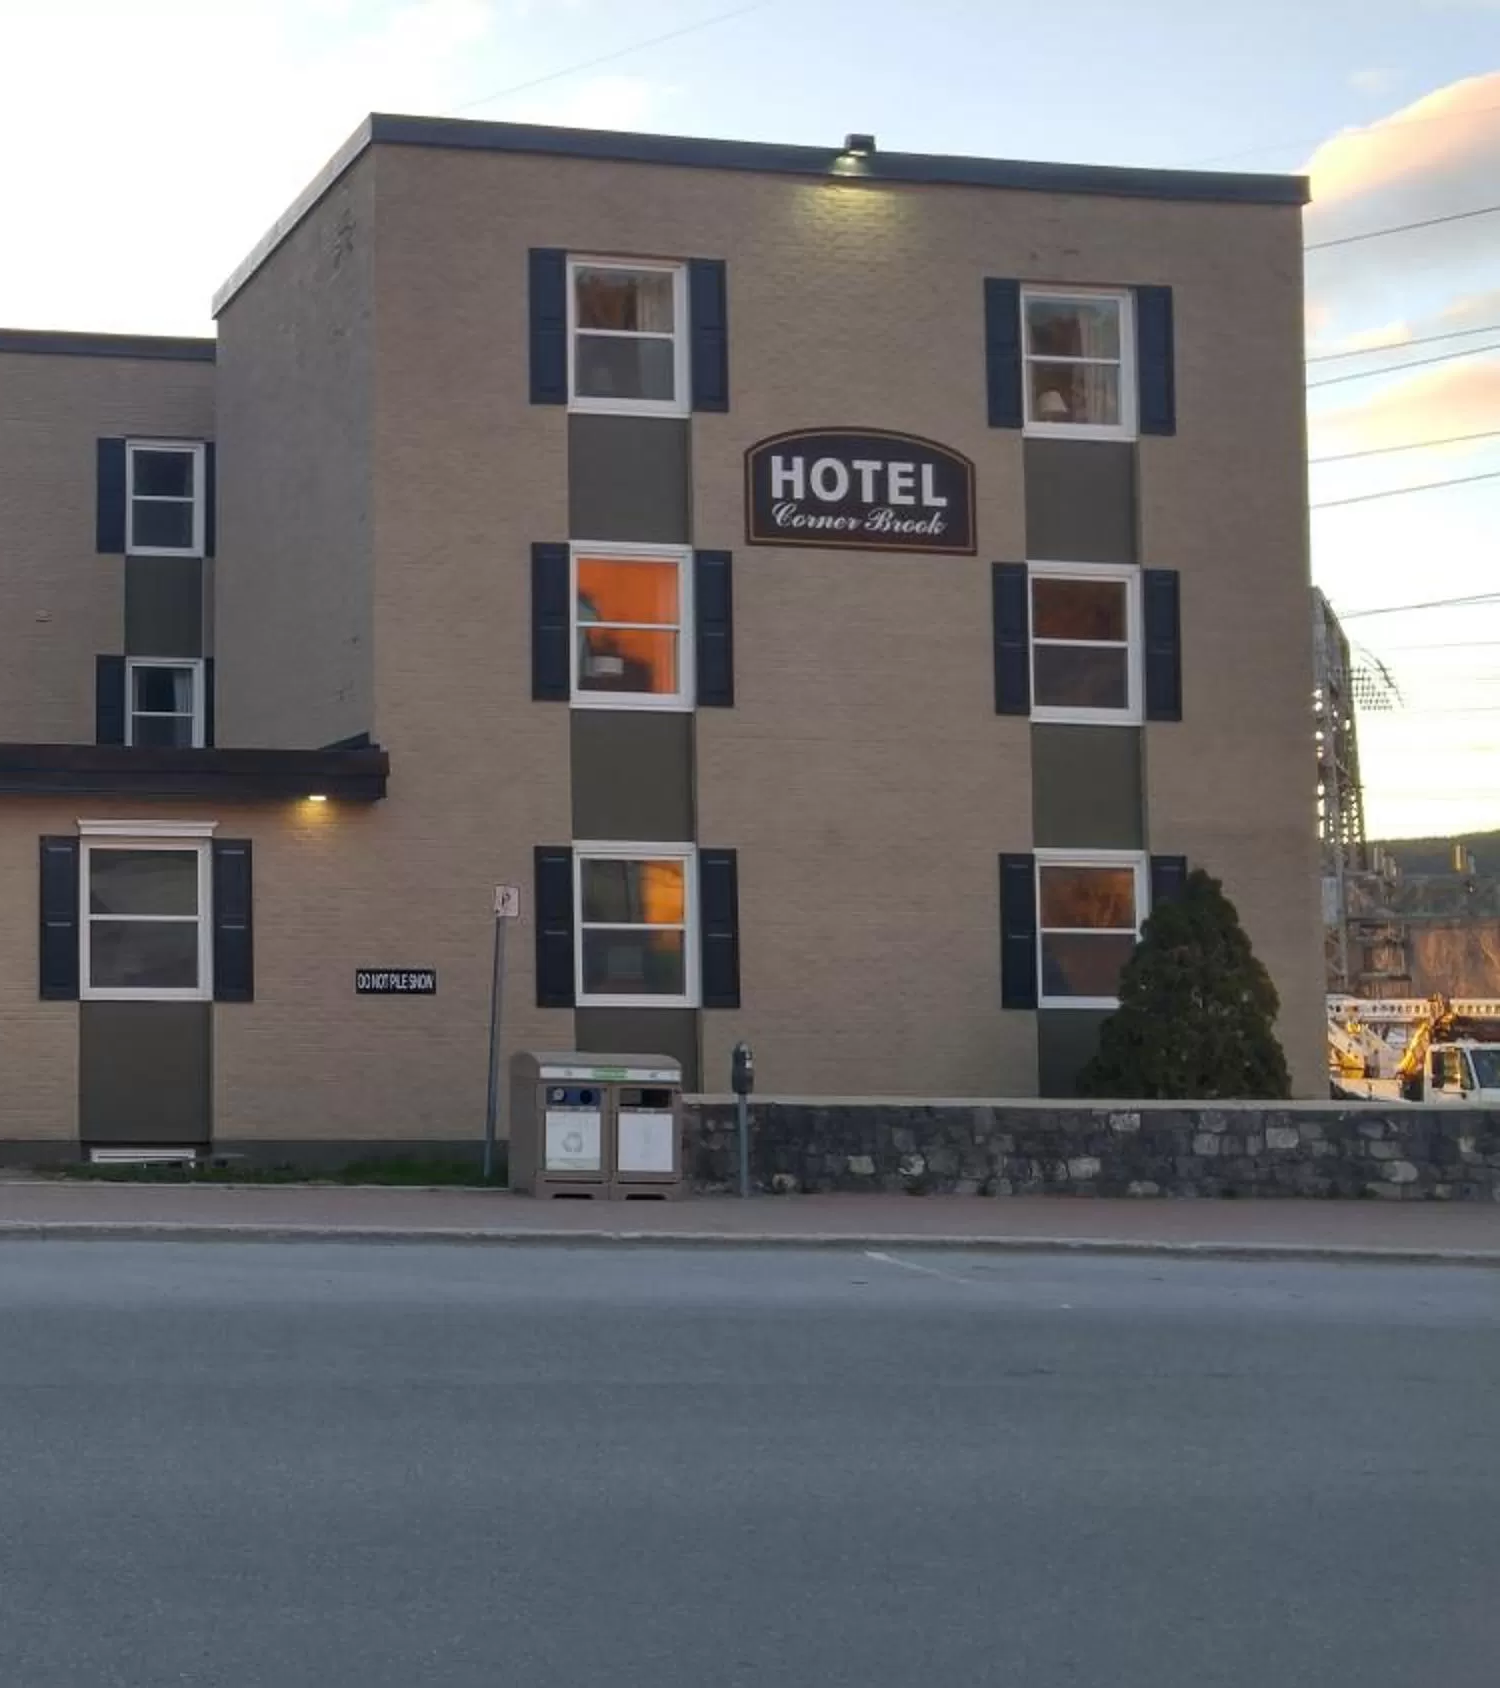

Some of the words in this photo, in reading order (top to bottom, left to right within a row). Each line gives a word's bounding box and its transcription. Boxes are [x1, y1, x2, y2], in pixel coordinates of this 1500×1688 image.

[771, 455, 948, 507] HOTEL
[771, 500, 860, 532] Corner
[864, 507, 948, 535] Brook
[372, 971, 389, 989] NOT
[389, 971, 407, 989] PILE
